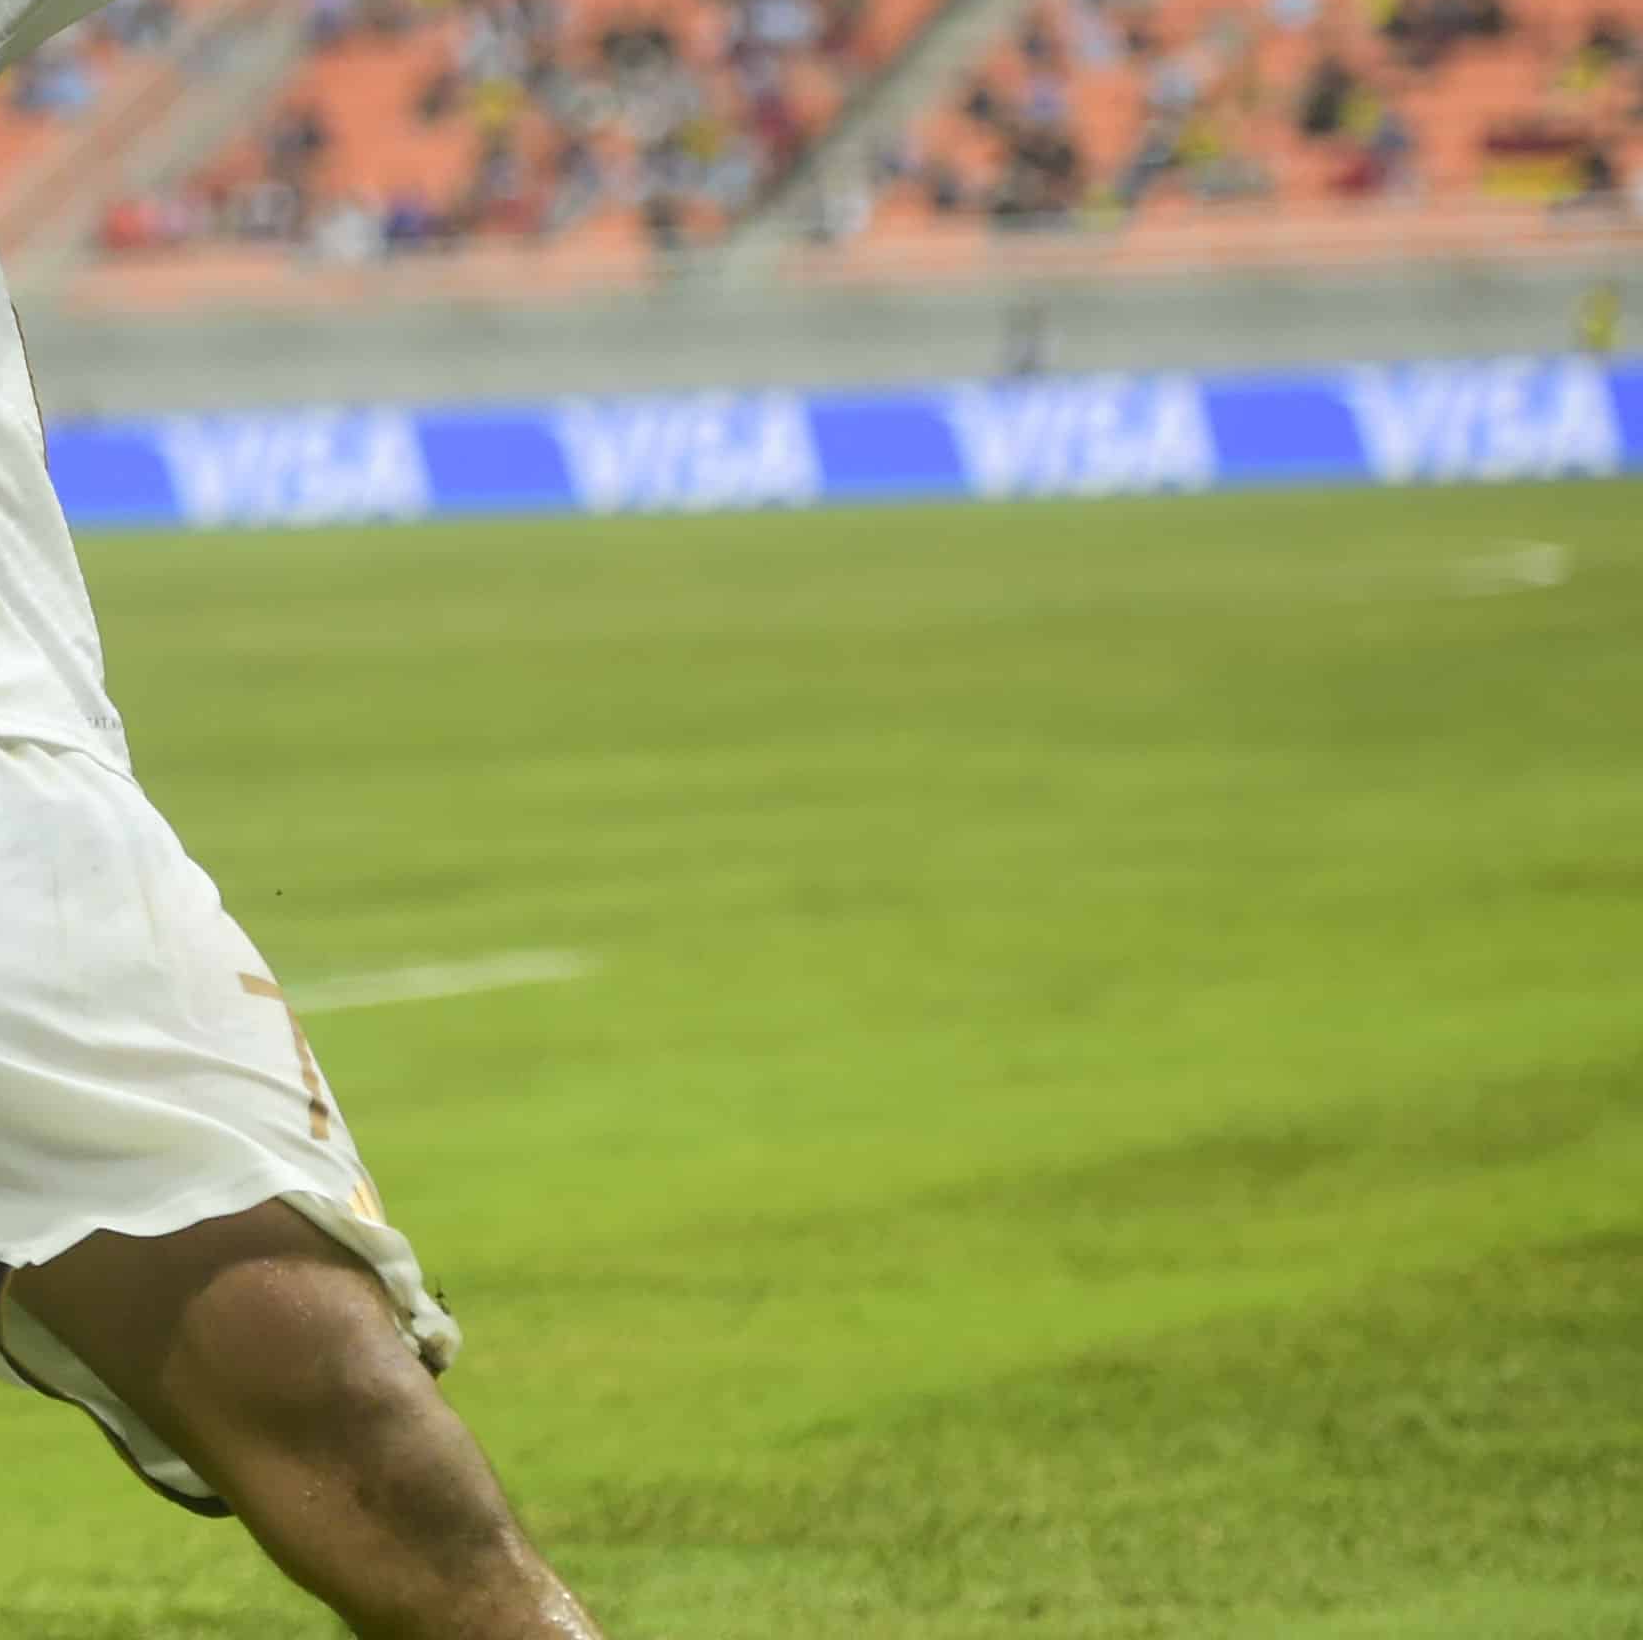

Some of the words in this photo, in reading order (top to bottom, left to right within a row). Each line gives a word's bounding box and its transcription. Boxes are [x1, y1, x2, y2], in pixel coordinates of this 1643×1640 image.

[159, 412, 434, 527] VISA
[555, 392, 824, 514] VISA
[948, 376, 1221, 499] VISA
[1344, 360, 1621, 484] VISA
